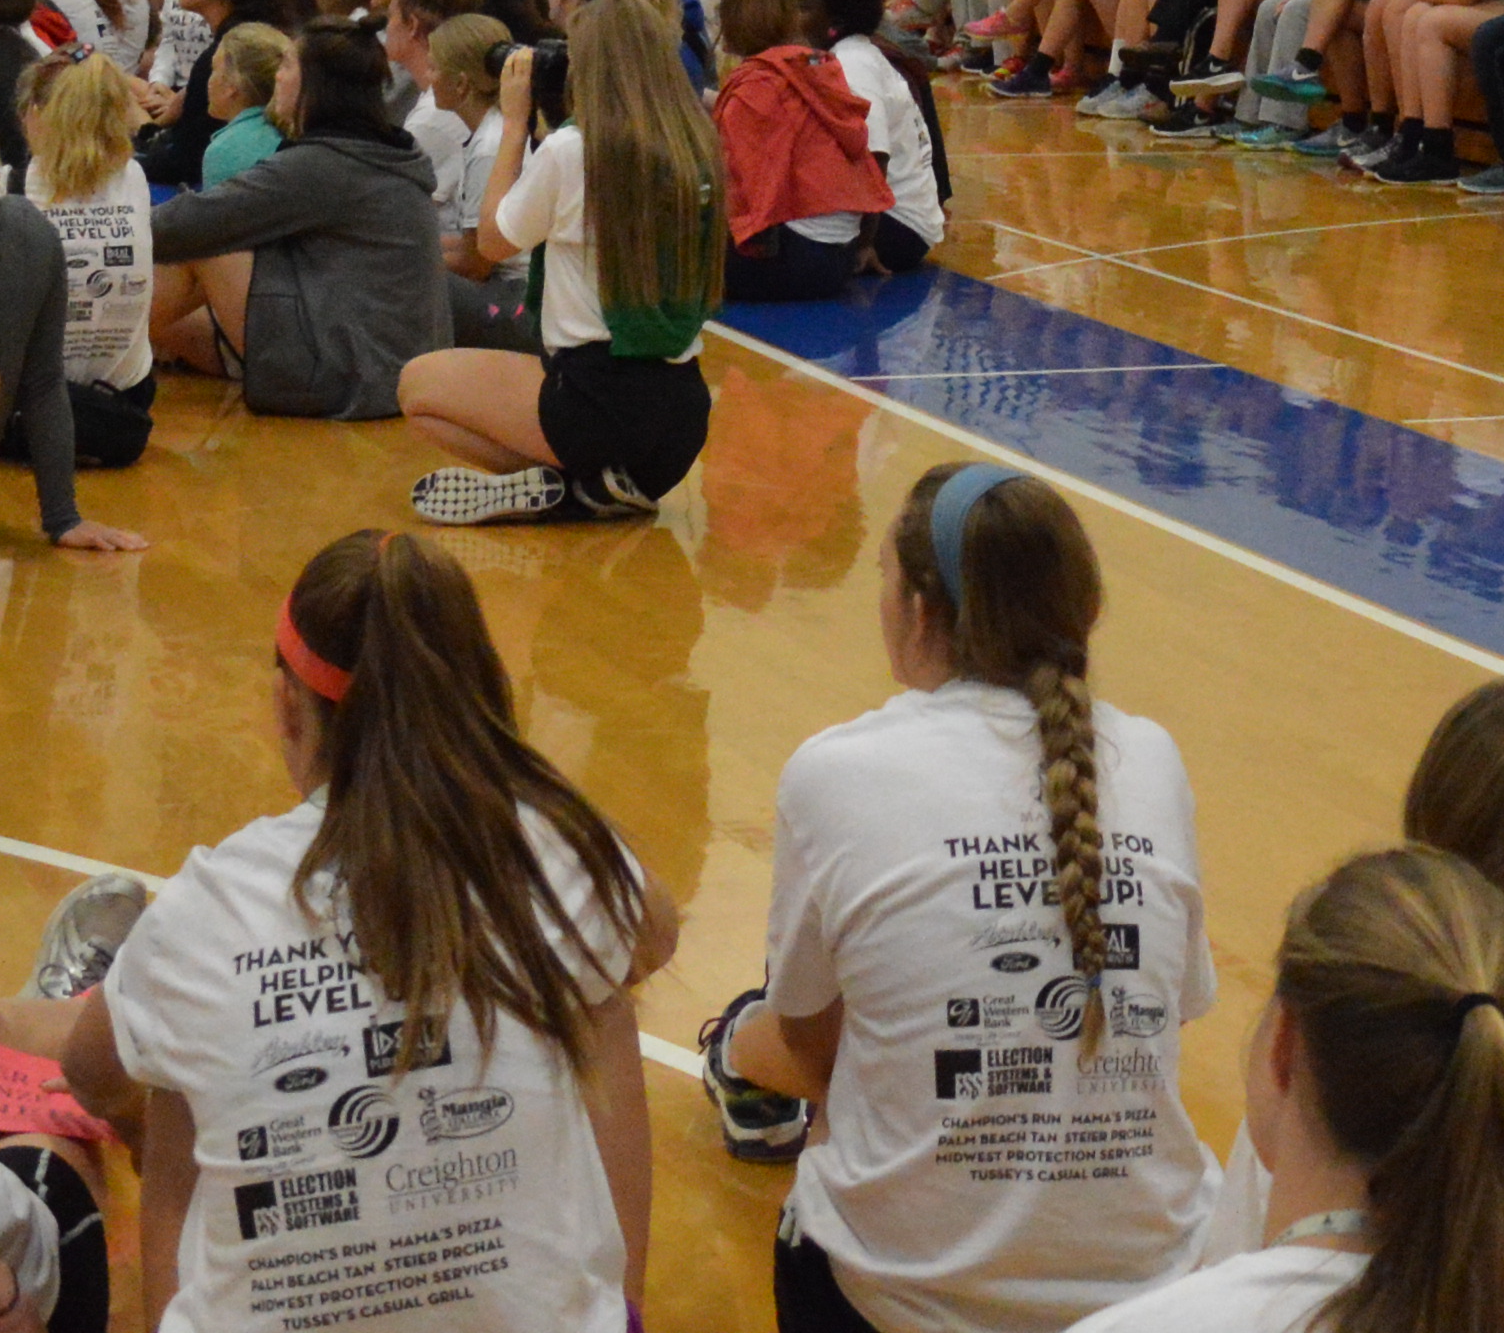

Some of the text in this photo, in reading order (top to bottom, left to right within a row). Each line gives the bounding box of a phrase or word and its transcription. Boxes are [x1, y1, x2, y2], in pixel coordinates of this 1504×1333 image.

[944, 833, 1154, 857] THANK FOR
[980, 858, 1134, 880] HELPI US
[973, 881, 1060, 909] LEVE
[233, 937, 327, 975] THANK
[252, 983, 372, 1027] LEVEL
[983, 994, 1015, 1004] Great
[983, 1006, 1029, 1016] Western
[984, 1018, 1011, 1028] Bank
[988, 1047, 1053, 1067] ELECTION
[988, 1067, 1039, 1082] SYSTEMS
[988, 1081, 1051, 1096] SOFTWARE
[442, 1093, 507, 1117] Mangia
[269, 1115, 305, 1131] Great
[942, 1109, 1157, 1129] CHAMPION'S RUN MAMA'S PIZZA
[270, 1125, 322, 1142] Western
[938, 1128, 1154, 1146] PALM BEACH TAN STEIER PRCHAL
[272, 1144, 304, 1157] Bank
[936, 1145, 1153, 1163] MIDWEST PROTECTION SERVICES
[386, 1148, 516, 1193] Creighton
[971, 1168, 1128, 1181] TUSSEY'S CASUAL GRILL
[280, 1169, 356, 1198] ELECTION
[284, 1194, 343, 1215] SYSTEMS
[388, 1175, 519, 1214] UNIVERSITY
[285, 1209, 360, 1231] SOFTWARE
[248, 1217, 502, 1271] CHAMPION'S RUN MAMA'S PIZZA
[251, 1238, 505, 1292] PALM BEACH TAN STEIER PRCHAL
[251, 1257, 508, 1313] MIDWEST PROTECTION SERVICES
[283, 1287, 474, 1331] TUSSEY'S CASUAL GRILL
